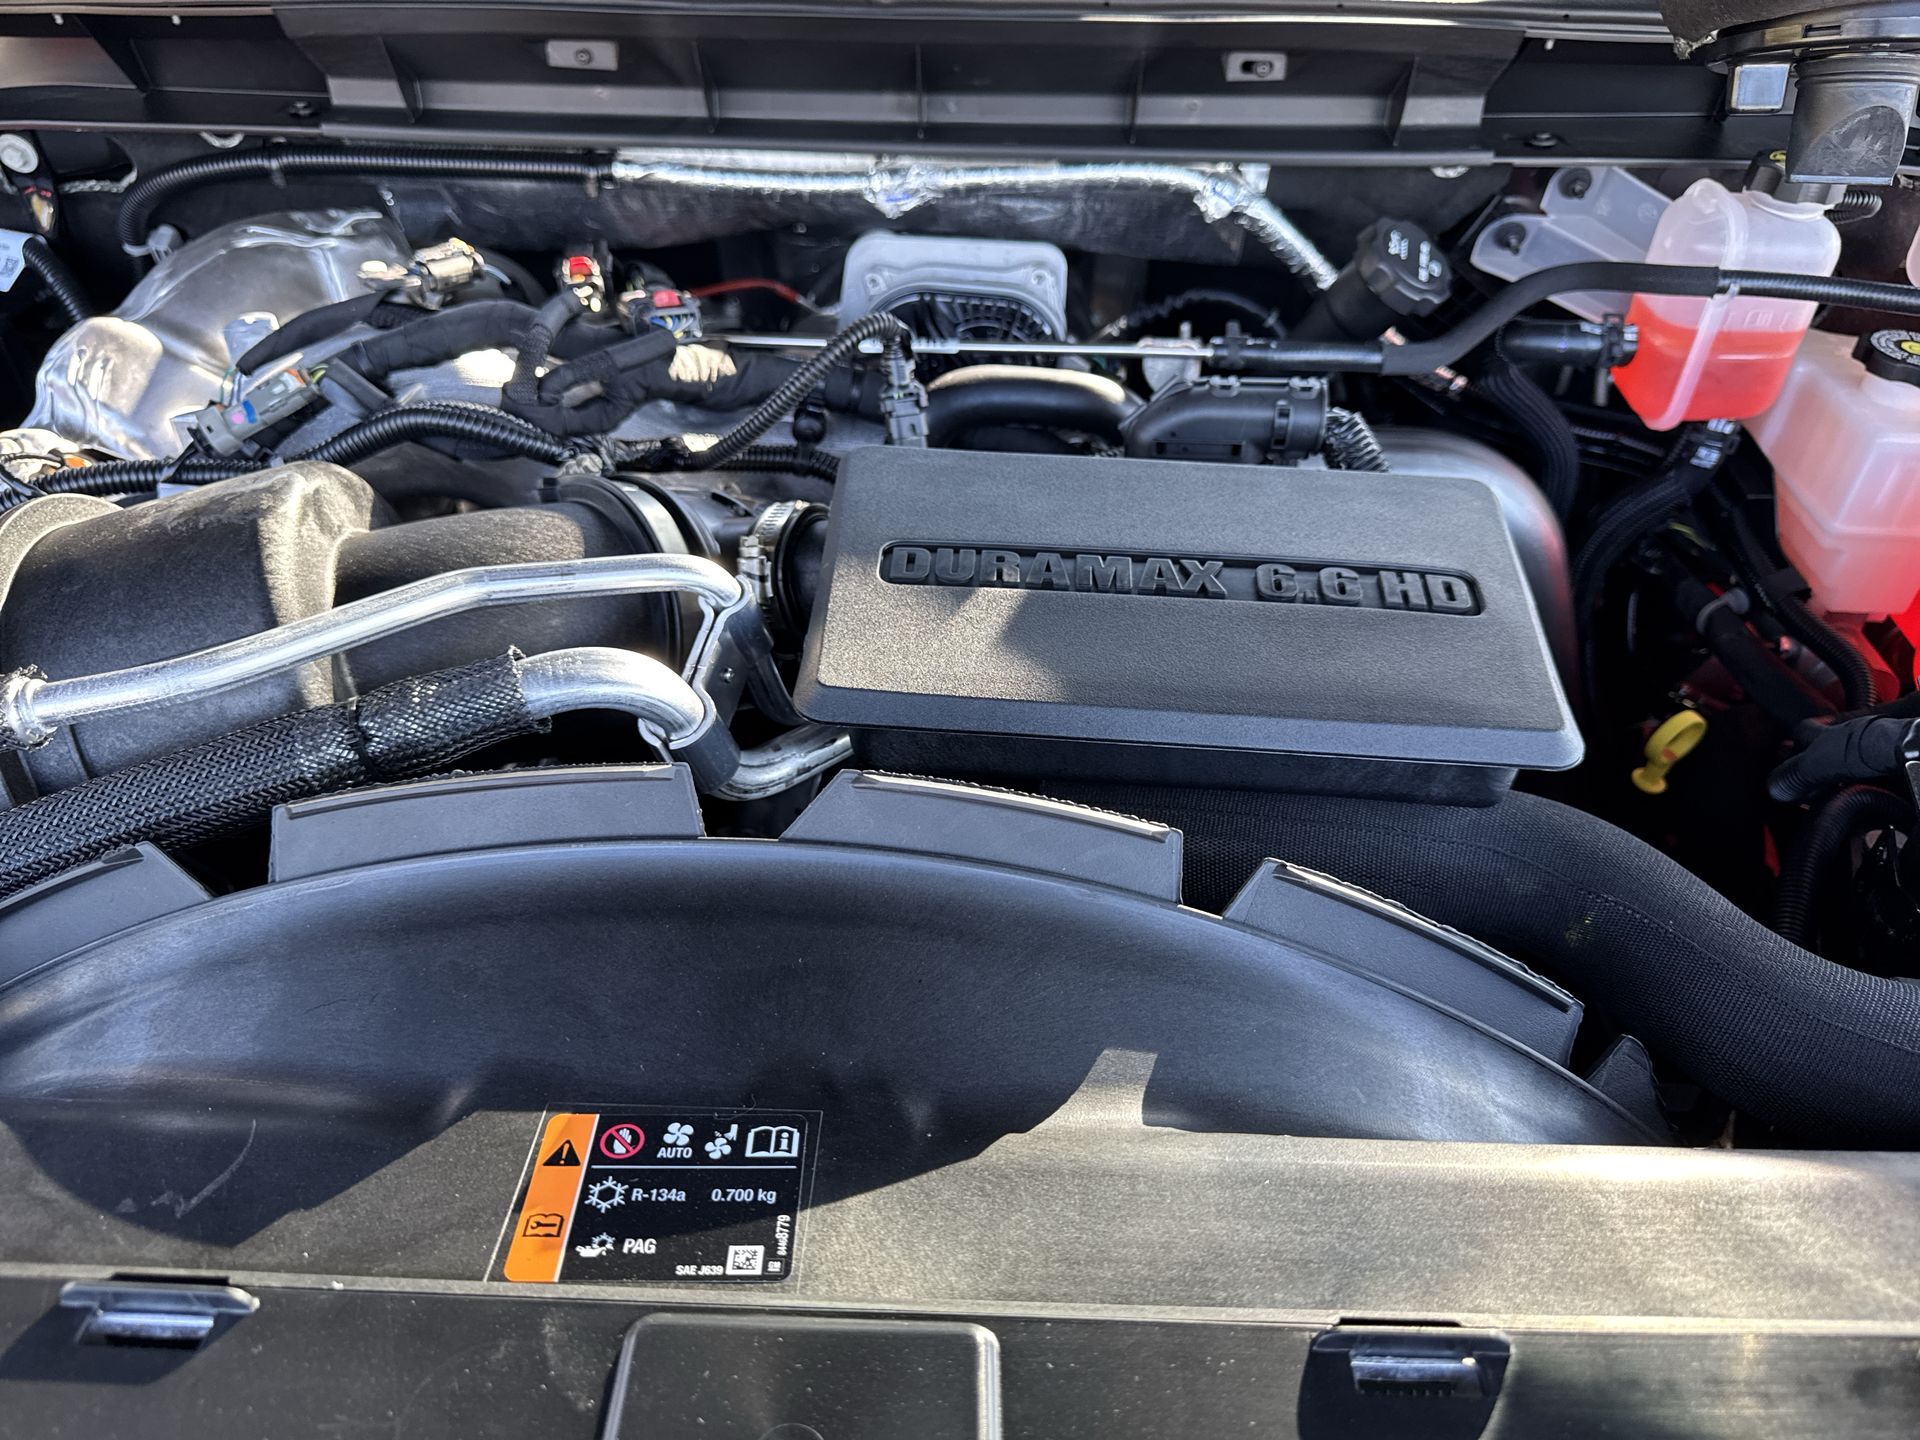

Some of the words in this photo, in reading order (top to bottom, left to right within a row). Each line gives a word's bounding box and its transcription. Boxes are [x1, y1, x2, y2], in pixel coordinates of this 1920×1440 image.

[889, 547, 1228, 597] DURAMAX
[1255, 563, 1363, 605] 6.6
[1376, 571, 1473, 612] HD
[657, 1147, 692, 1159] AUTO
[631, 1189, 686, 1202] R-134a
[711, 1189, 754, 1202] 0.700
[757, 1188, 777, 1204] kg
[622, 1238, 657, 1254] PAG
[675, 1265, 697, 1275] SAE
[698, 1265, 724, 1275] J639
